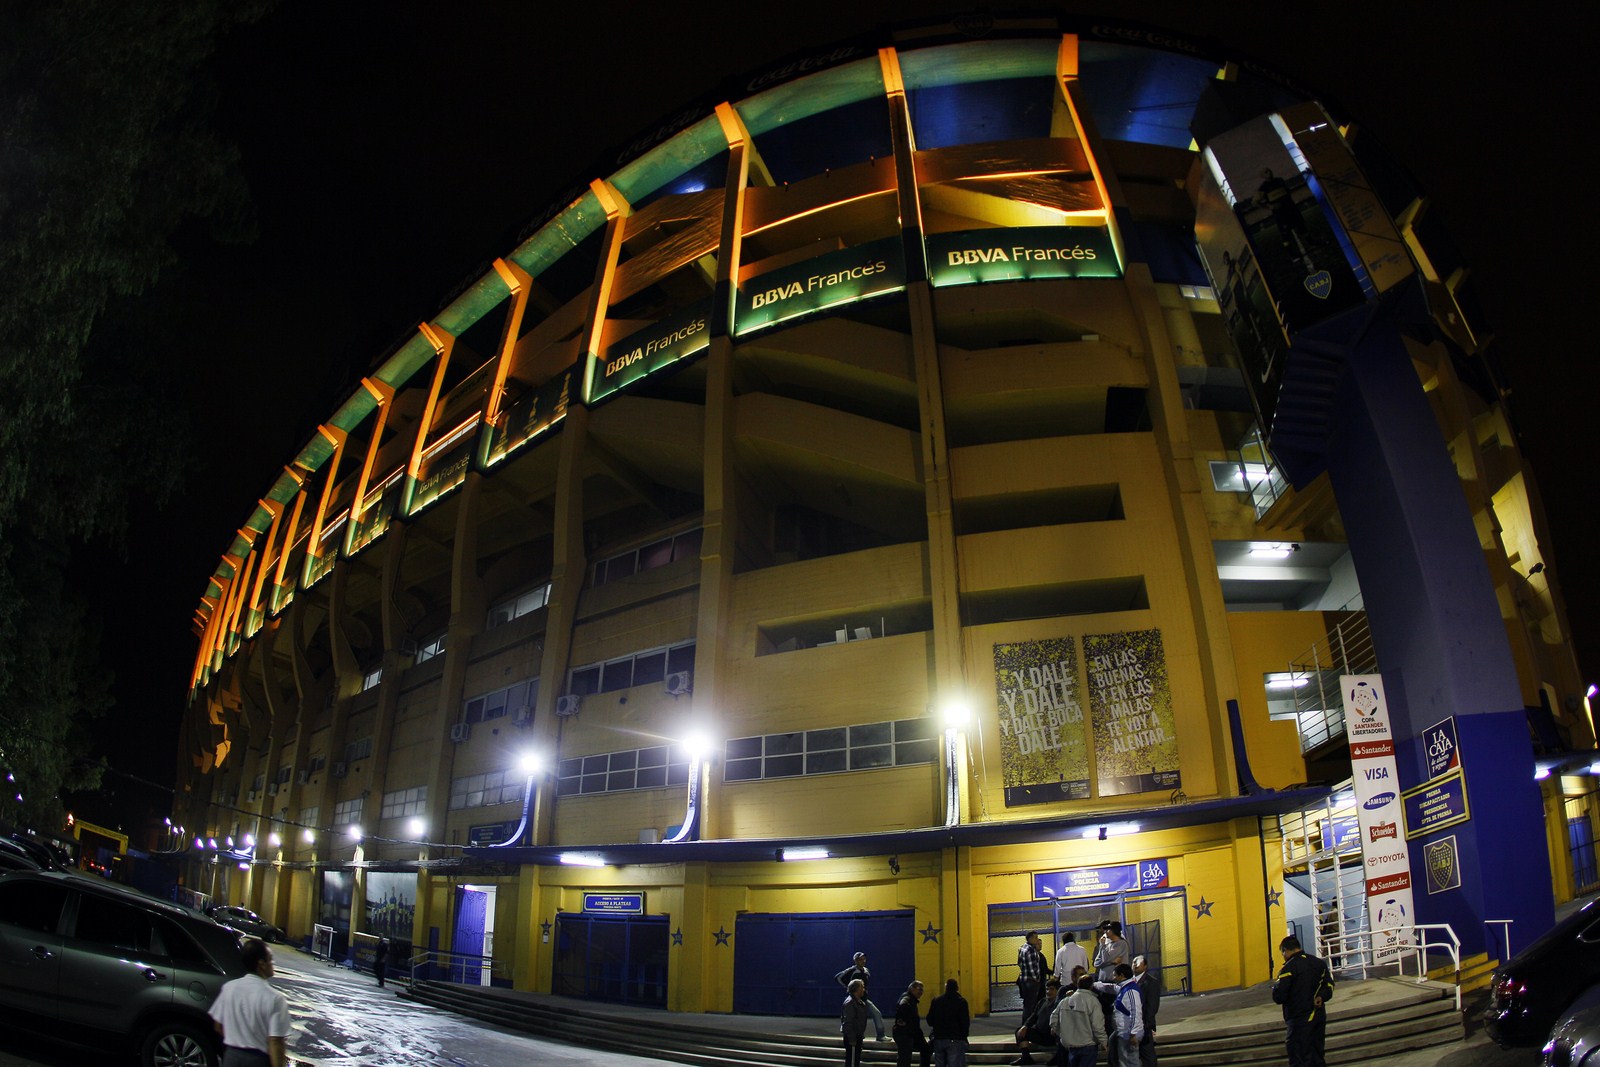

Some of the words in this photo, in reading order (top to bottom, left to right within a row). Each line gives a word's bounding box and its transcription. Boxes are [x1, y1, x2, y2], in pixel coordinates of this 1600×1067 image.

[948, 247, 1010, 266] BBVA
[1012, 244, 1097, 263] Francés
[752, 281, 805, 310] BBVA
[806, 258, 887, 294] Francés
[605, 346, 645, 378] BBVA
[645, 317, 705, 356] Francés
[1114, 648, 1138, 668] LAS
[1013, 670, 1025, 691] Y
[1029, 660, 1074, 689] DALE
[1095, 663, 1145, 688] BUENAS
[1001, 691, 1017, 719] Y
[1022, 681, 1077, 715] DALE
[1098, 690, 1107, 704] Y
[1110, 684, 1128, 702] EN
[1129, 678, 1154, 697] LAS
[1110, 696, 1153, 720] MALAS
[1000, 719, 1010, 737] Y
[1012, 713, 1046, 735] DALE
[1047, 704, 1084, 727] BOCA
[1106, 720, 1123, 738] TE
[1123, 713, 1148, 733] VOY
[1151, 710, 1160, 727] A
[1354, 722, 1384, 730] SANTANDER
[1352, 727, 1388, 736] LIBERTADORES
[1432, 729, 1446, 744] LA
[1361, 744, 1392, 755] Santander
[1428, 738, 1453, 757] CAJA
[1364, 767, 1389, 780] VISA
[1367, 796, 1393, 806] SAMSUNG
[1371, 826, 1395, 838] Schneider
[1378, 852, 1406, 864] TOYOTA
[1143, 869, 1165, 879] CAJA
[1377, 877, 1408, 891] Santander
